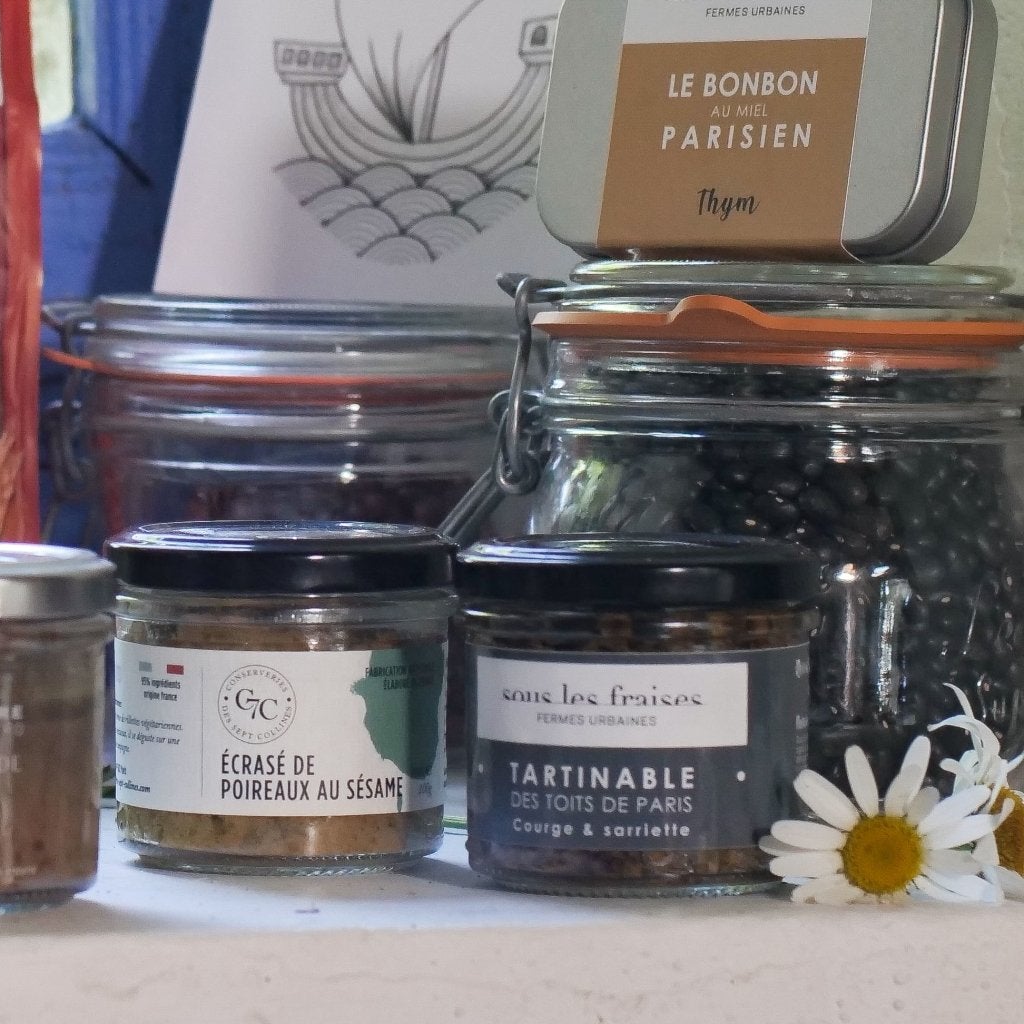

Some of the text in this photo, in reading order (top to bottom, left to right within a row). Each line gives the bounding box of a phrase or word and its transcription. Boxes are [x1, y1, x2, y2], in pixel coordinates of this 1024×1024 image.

[706, 5, 806, 18] FERMES URBAINES
[668, 70, 819, 98] LE BONBON
[711, 104, 768, 117] AU MIEL
[661, 123, 812, 150] PARISIEN
[696, 187, 760, 221] Thym
[226, 669, 288, 692] CONSERVERIES
[562, 684, 598, 706] les
[611, 684, 703, 706] fraises
[536, 712, 656, 726] FERMES URBAINES
[231, 724, 254, 740] SEPT
[221, 749, 315, 775] ÉCRASÉ DE
[221, 779, 310, 801] POIREAUX
[318, 779, 339, 801] AU
[347, 772, 403, 801] SÉSAME
[510, 762, 695, 790] TARTINABLE
[510, 791, 693, 813] DES TOITS DE PARIS
[513, 818, 690, 837] Courge & sarriette
